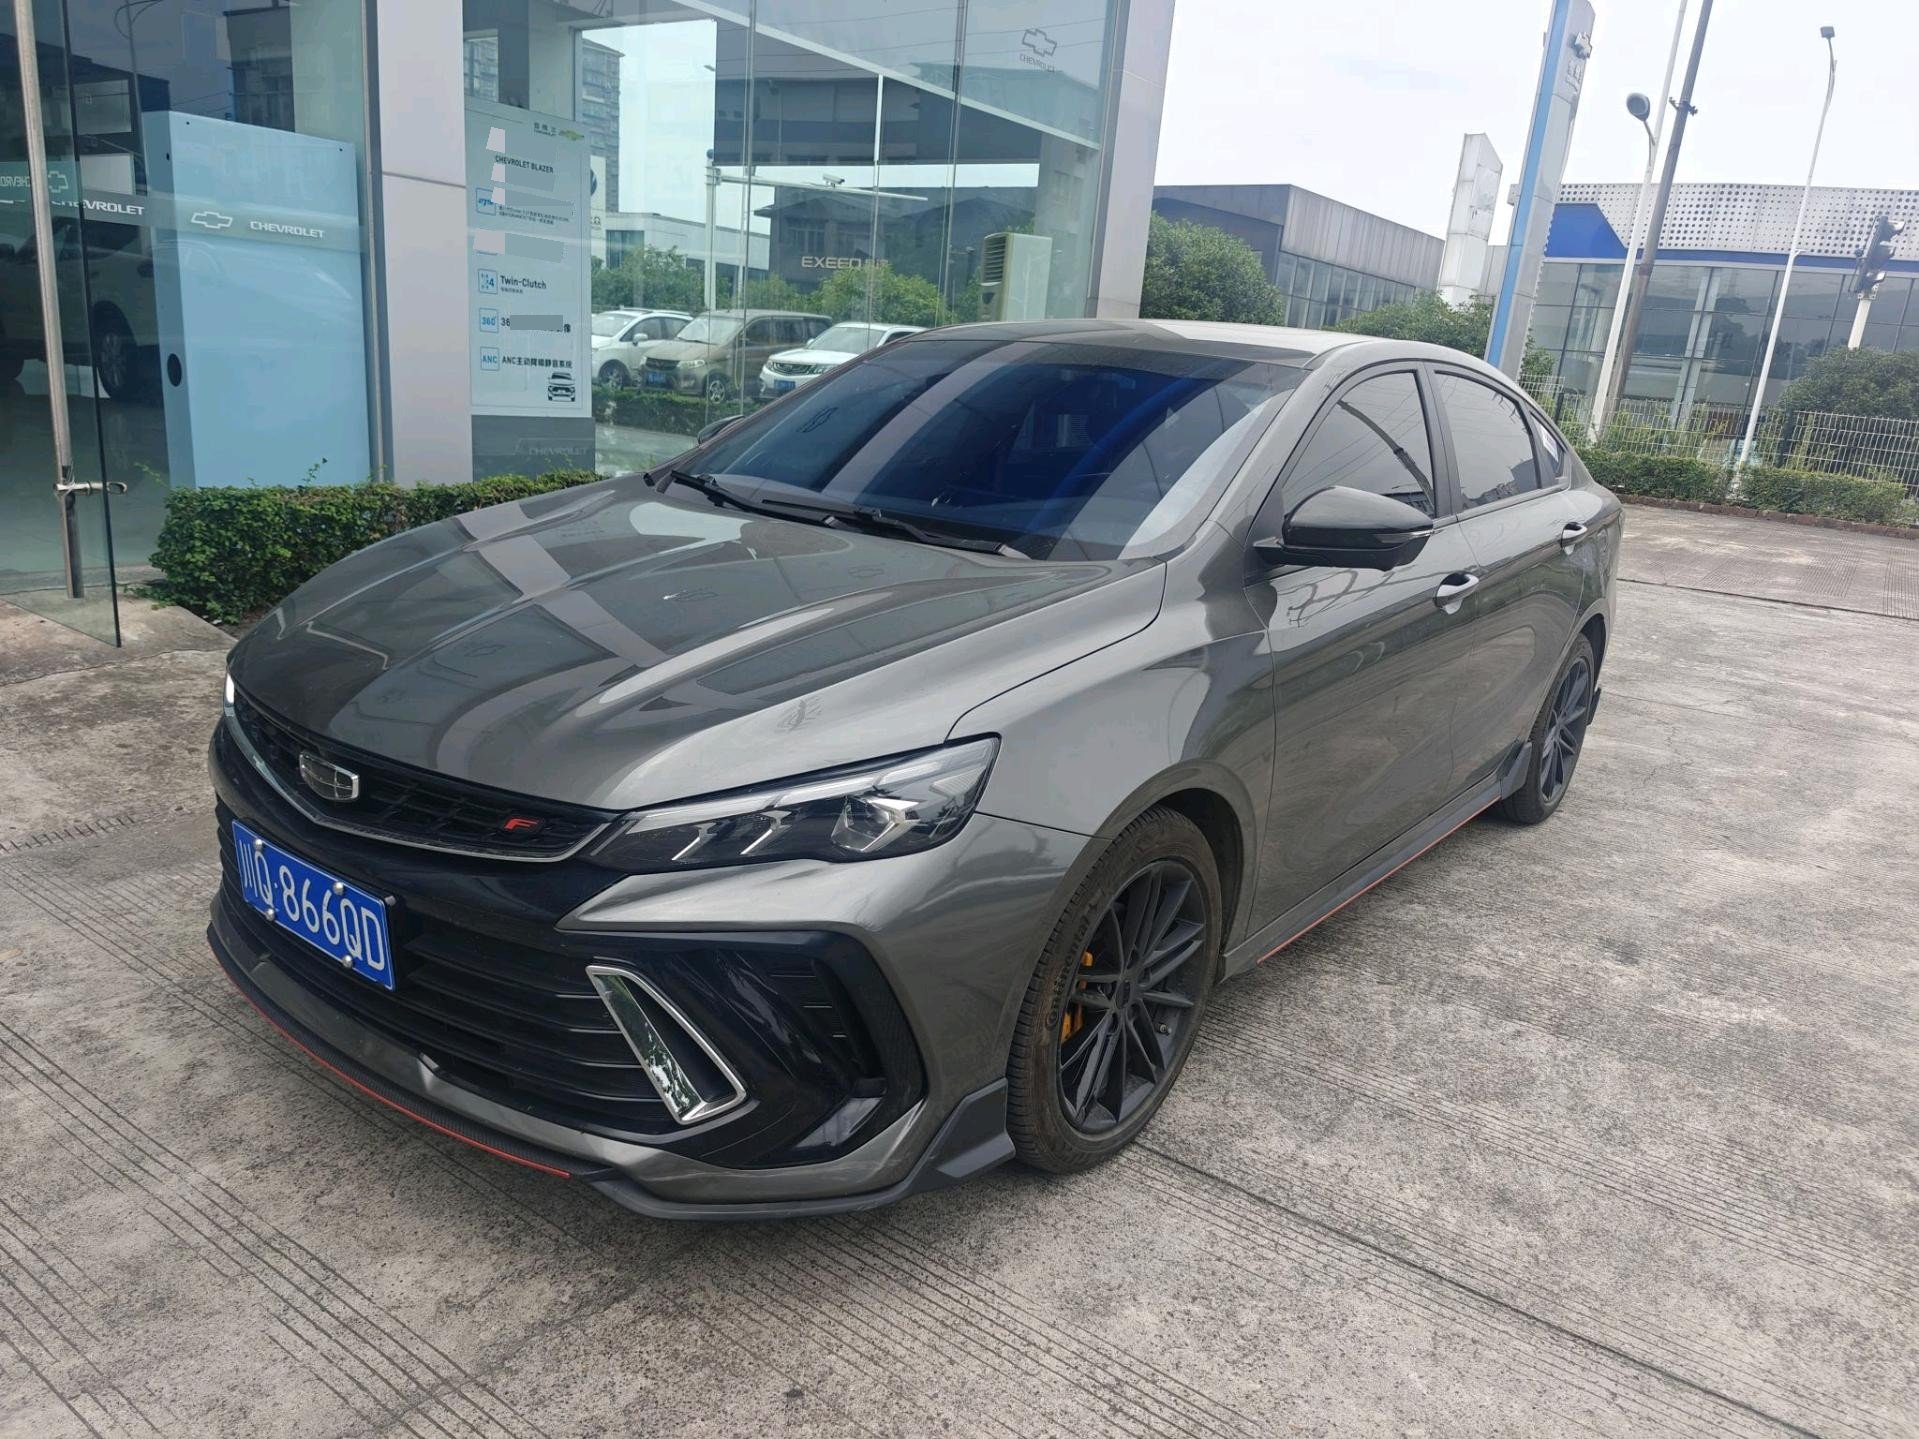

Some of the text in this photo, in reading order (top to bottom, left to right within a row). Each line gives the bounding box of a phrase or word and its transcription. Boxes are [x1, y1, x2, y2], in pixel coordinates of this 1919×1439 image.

[495, 155, 554, 174] CHEVROLET BLAZER
[250, 220, 325, 239] CHEVROLET
[500, 275, 547, 290] Twin-Clutch
[482, 355, 497, 364] ANC
